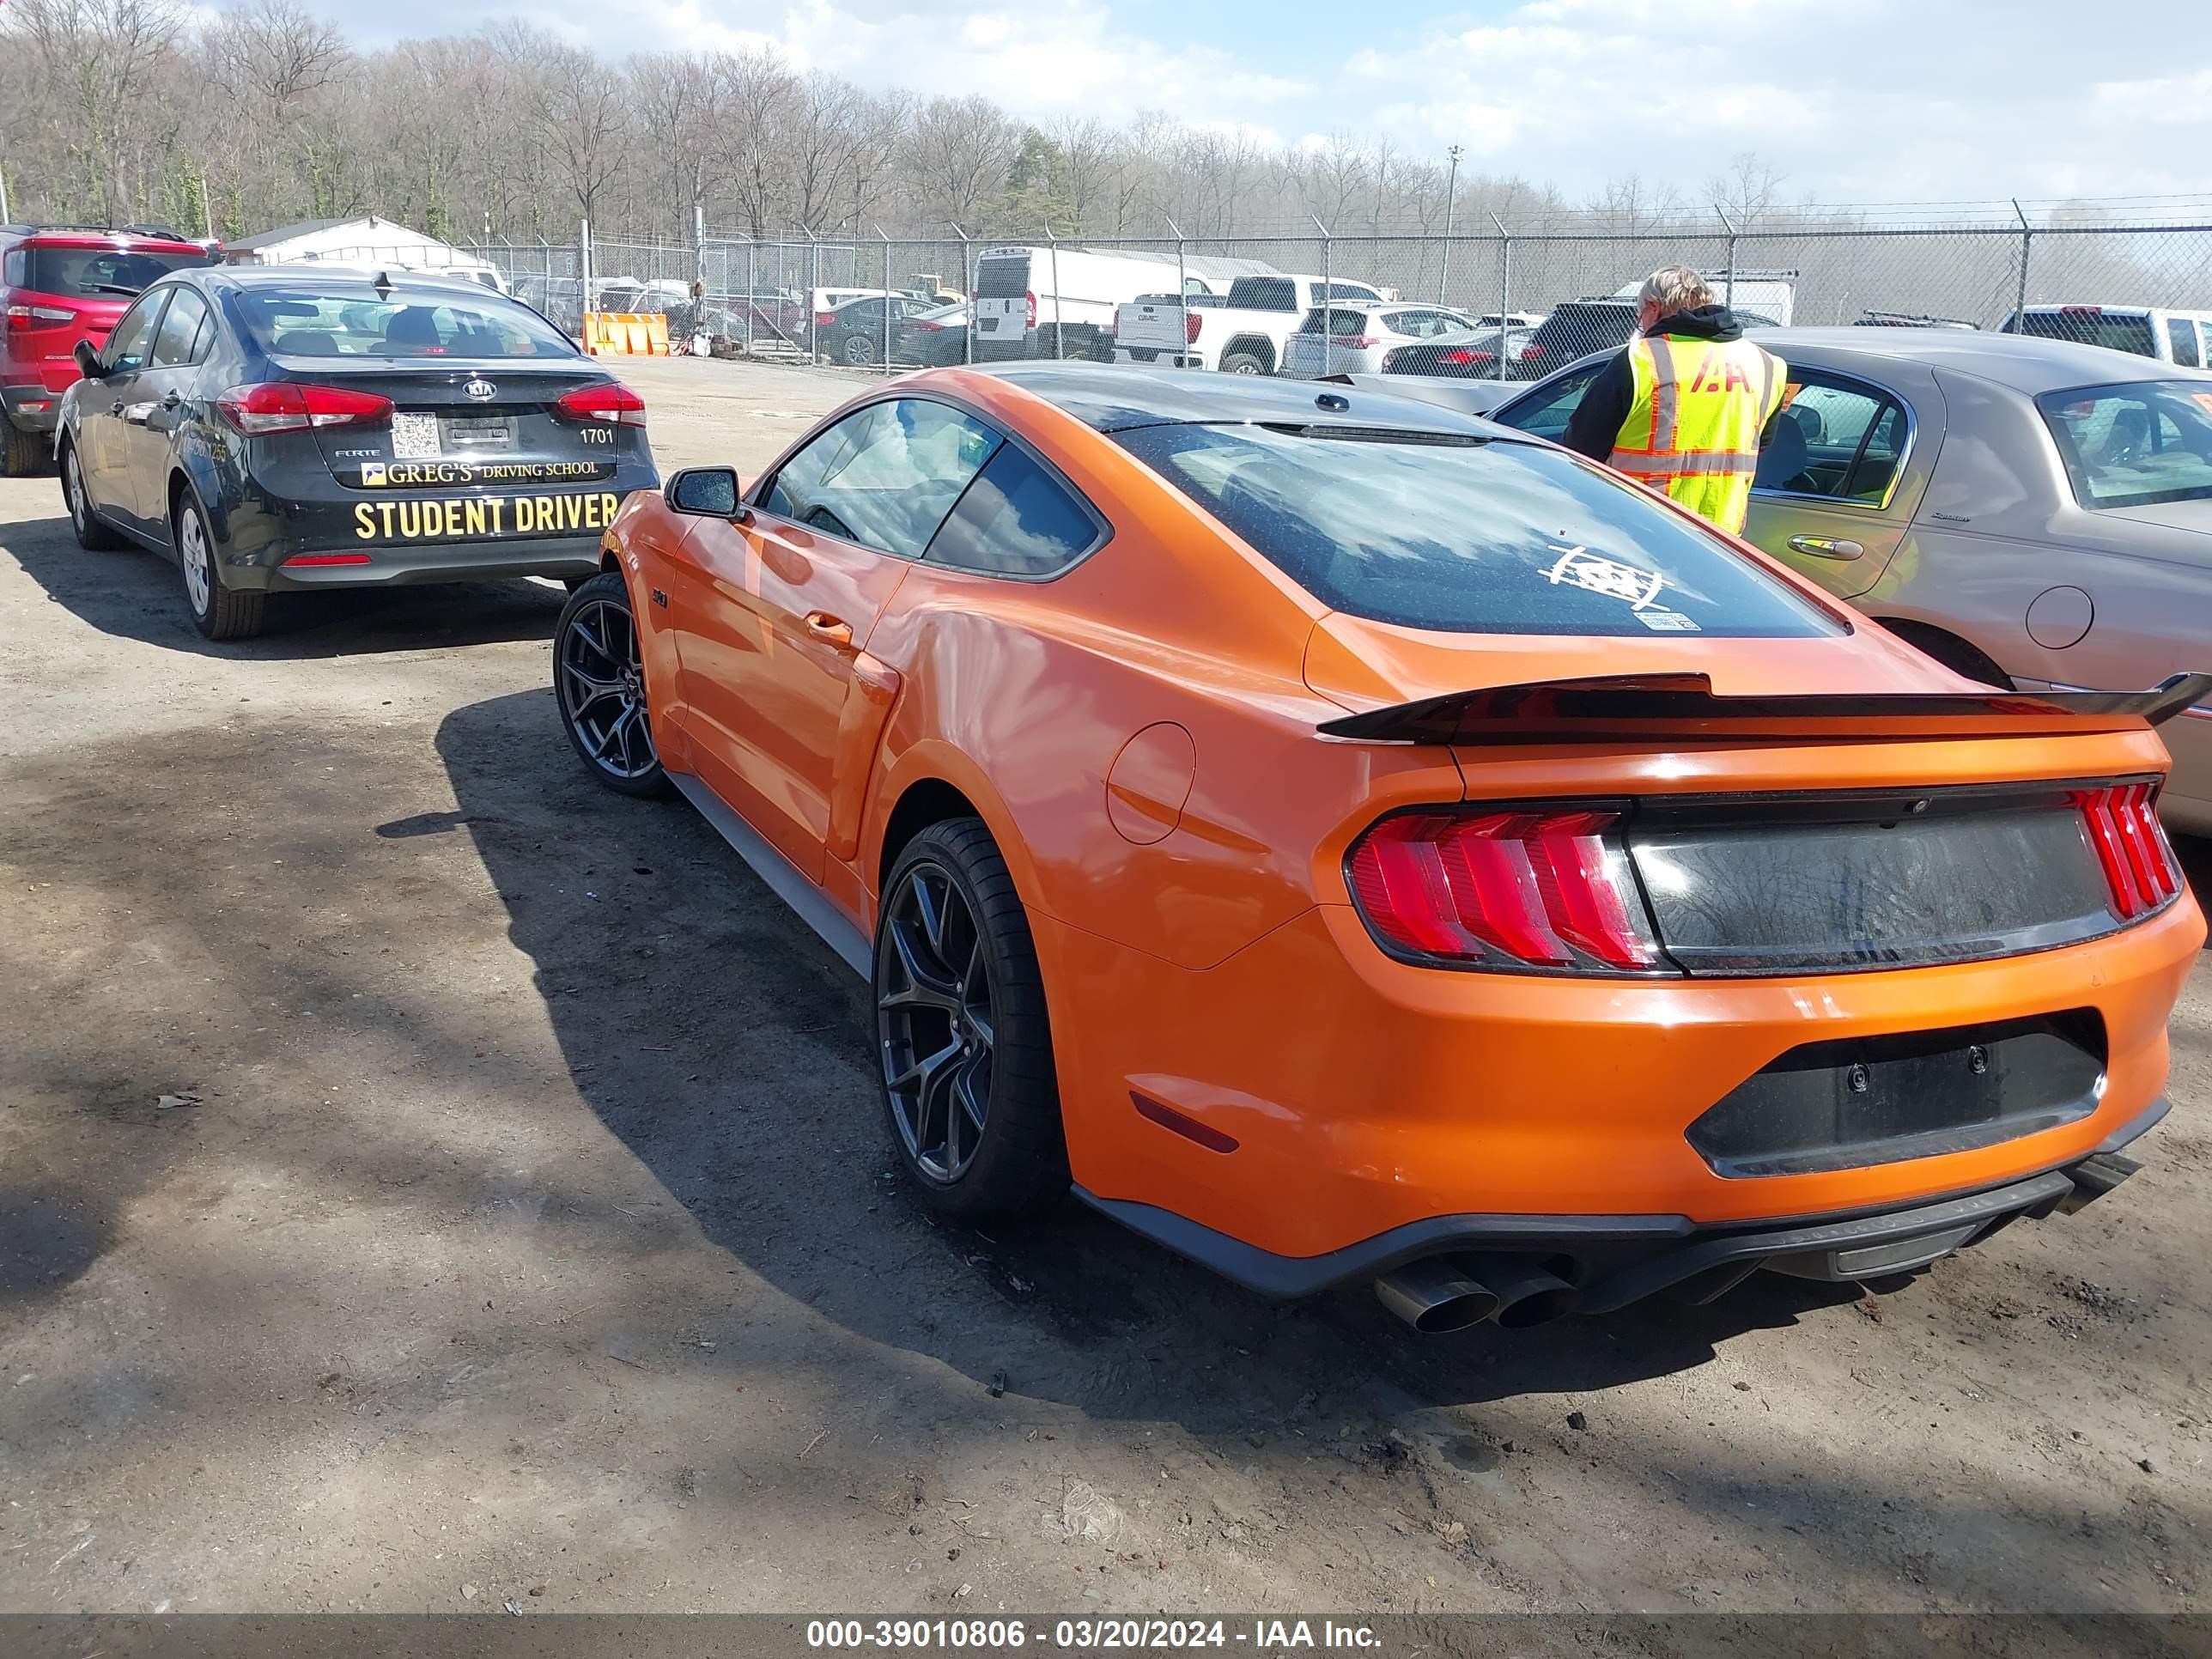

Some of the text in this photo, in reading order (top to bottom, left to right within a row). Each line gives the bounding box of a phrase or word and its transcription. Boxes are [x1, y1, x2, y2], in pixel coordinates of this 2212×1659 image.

[465, 382, 495, 397] KIA
[580, 428, 613, 444] 1701
[335, 449, 381, 458] FORTE
[388, 461, 599, 483] GREG'S DRIVING SCHOOL
[355, 493, 617, 539] STUDENT DRIVER
